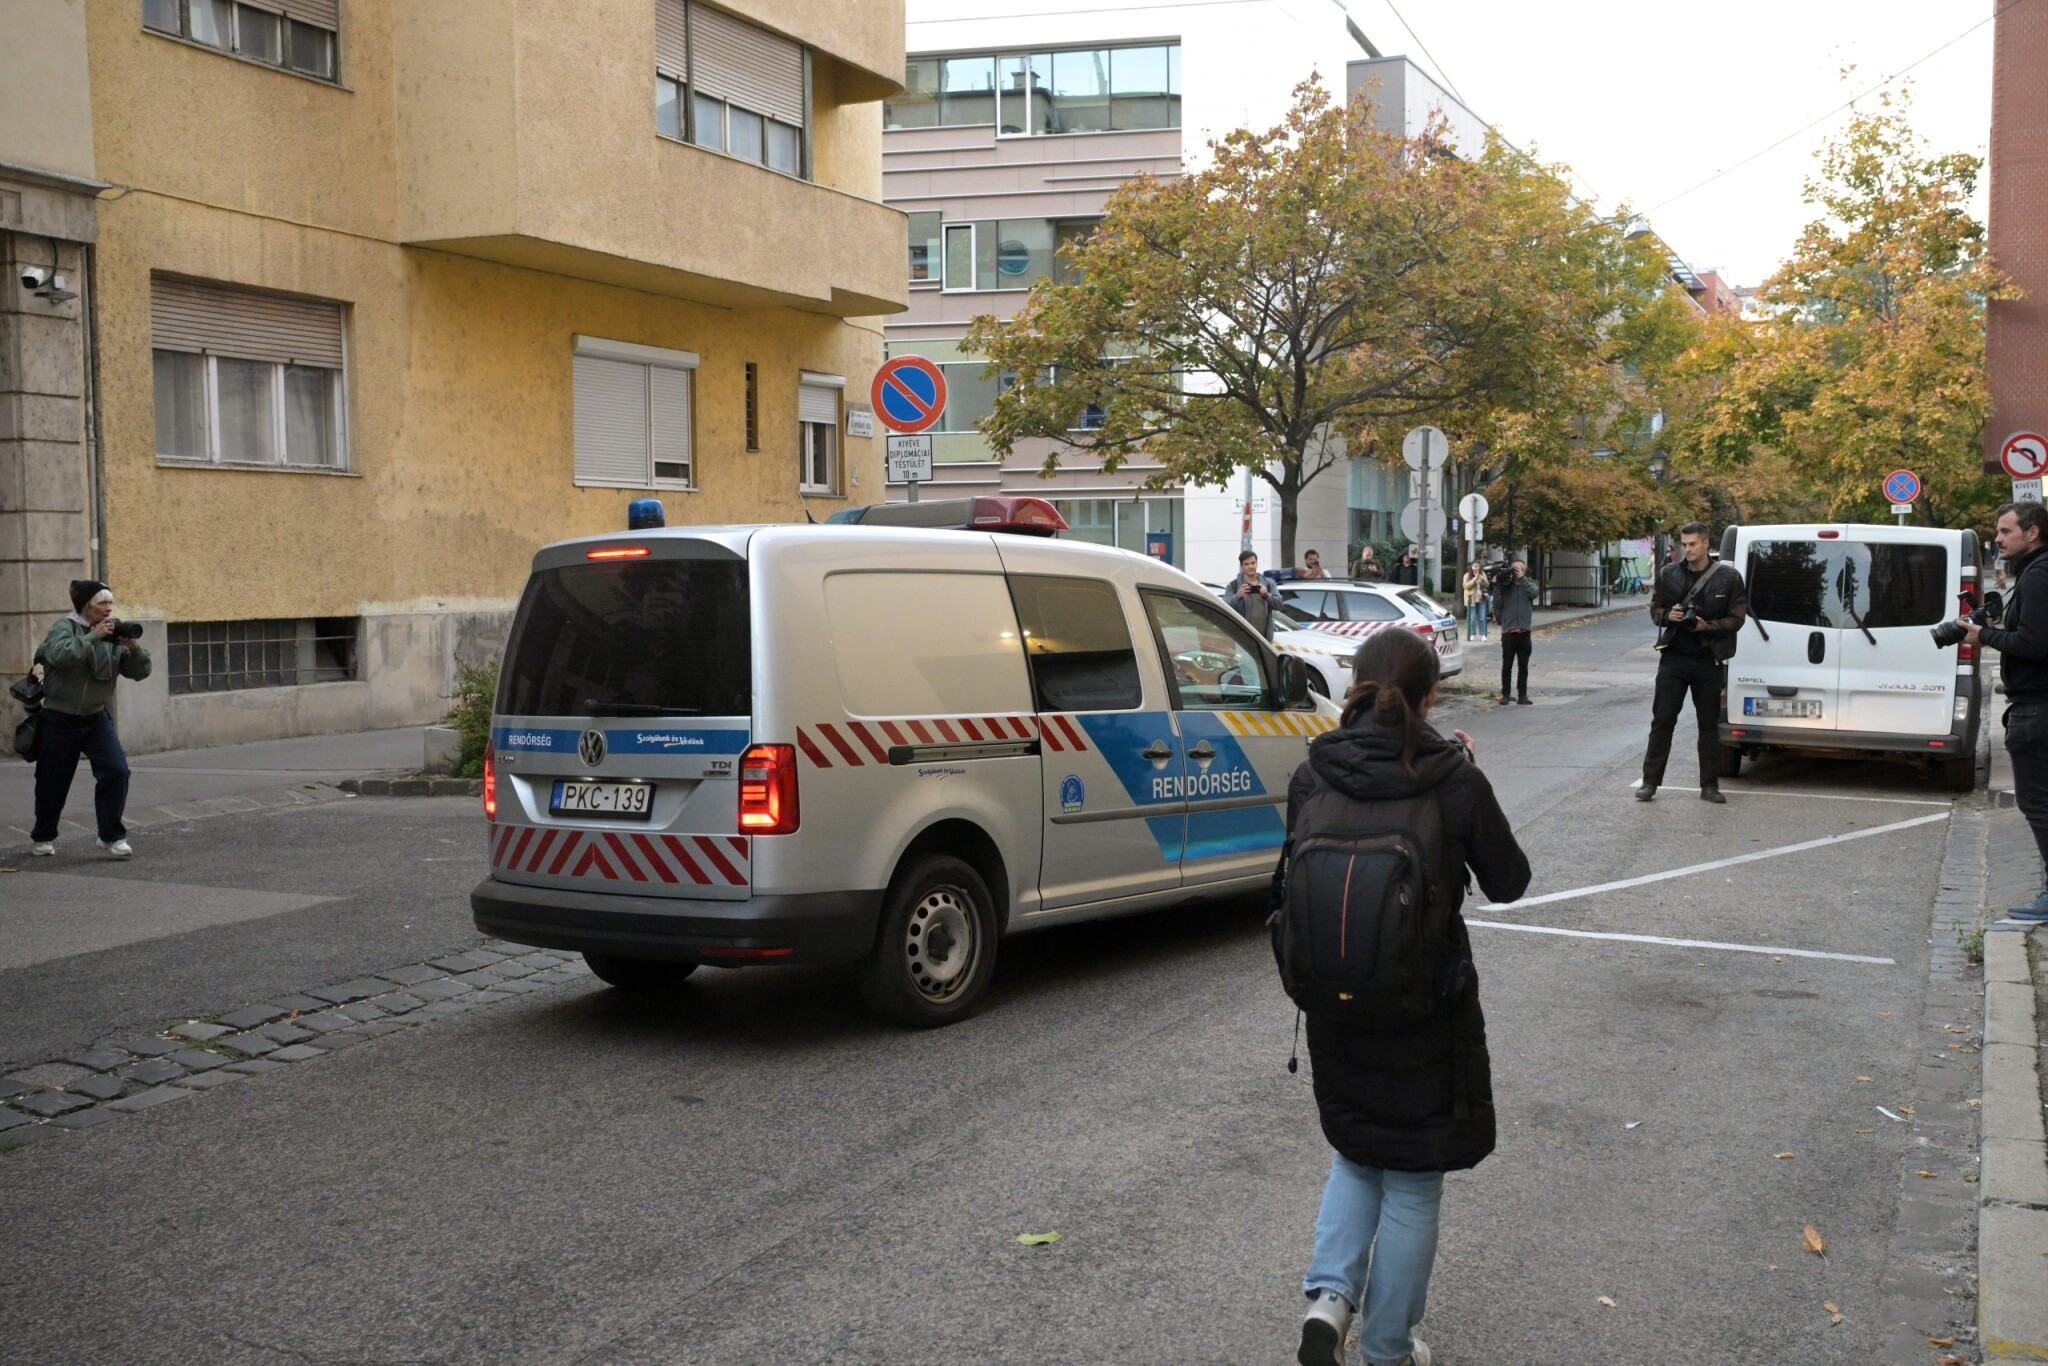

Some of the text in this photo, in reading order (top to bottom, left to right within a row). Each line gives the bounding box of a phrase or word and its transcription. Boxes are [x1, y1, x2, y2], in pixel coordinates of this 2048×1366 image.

[898, 438, 920, 448] KIVÉVE
[889, 448, 930, 459] DIPLOMÁCIAI
[903, 470, 910, 479] 10
[2015, 481, 2039, 490] KIVÉVE
[508, 732, 552, 747] RENDŐRSÉG
[637, 733, 705, 746] Szolgálunk és Védünk
[710, 760, 733, 770] TDI
[1152, 766, 1251, 799] RENDŐRSÉG
[564, 785, 646, 812] PKC-139
